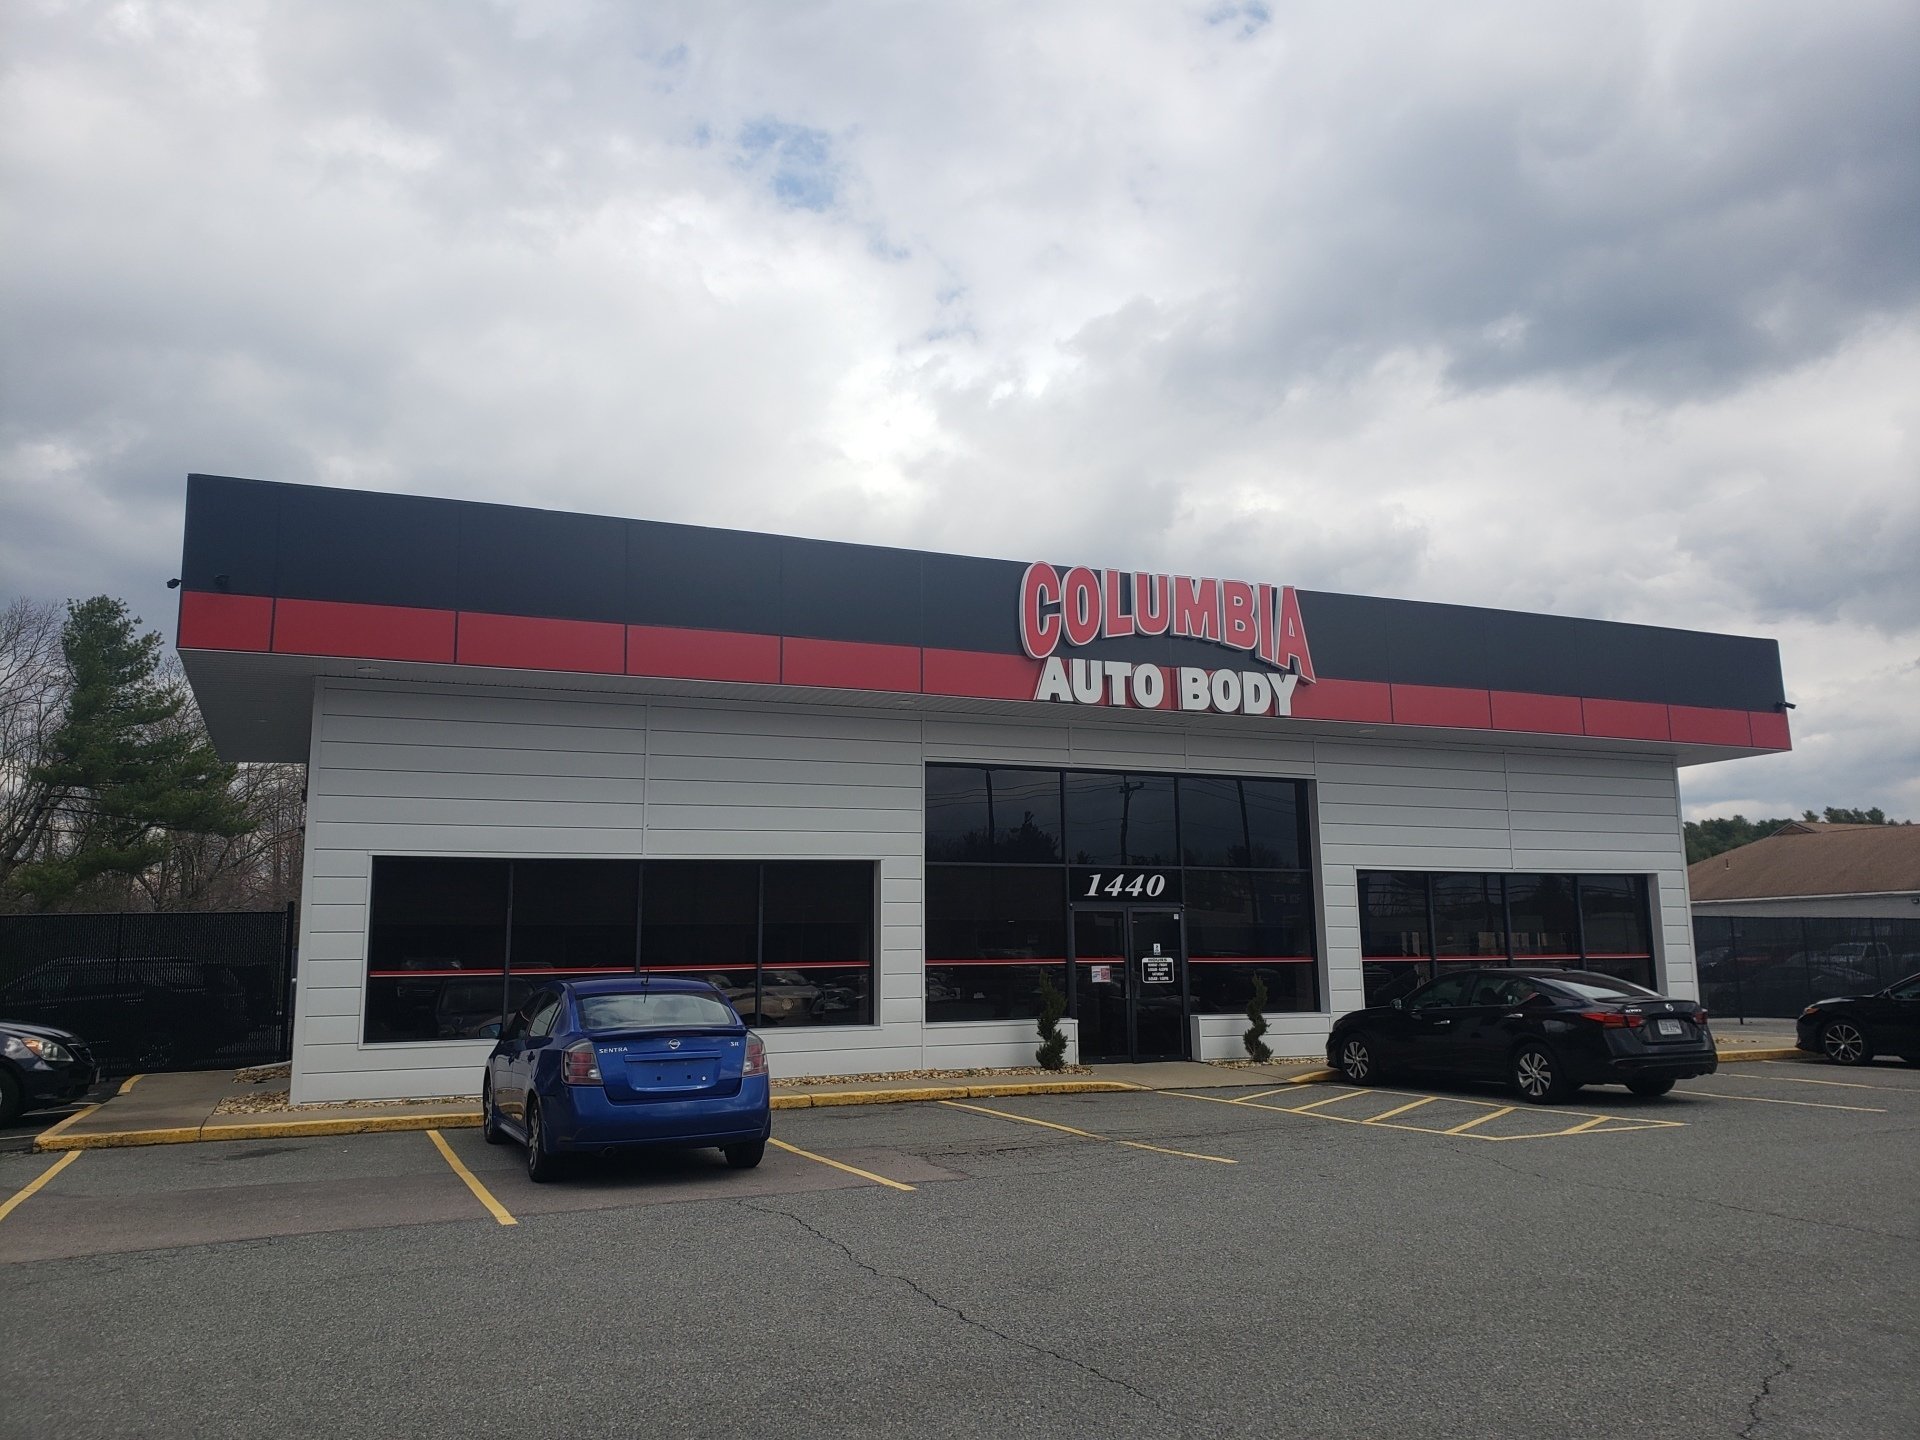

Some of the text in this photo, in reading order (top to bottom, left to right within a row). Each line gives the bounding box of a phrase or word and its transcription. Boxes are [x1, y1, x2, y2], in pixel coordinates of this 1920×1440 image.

[1019, 561, 1316, 683] COLUMBIA
[1034, 656, 1298, 716] AUTO BODY
[1084, 873, 1165, 896] 1440
[599, 1046, 628, 1054] SENTRA
